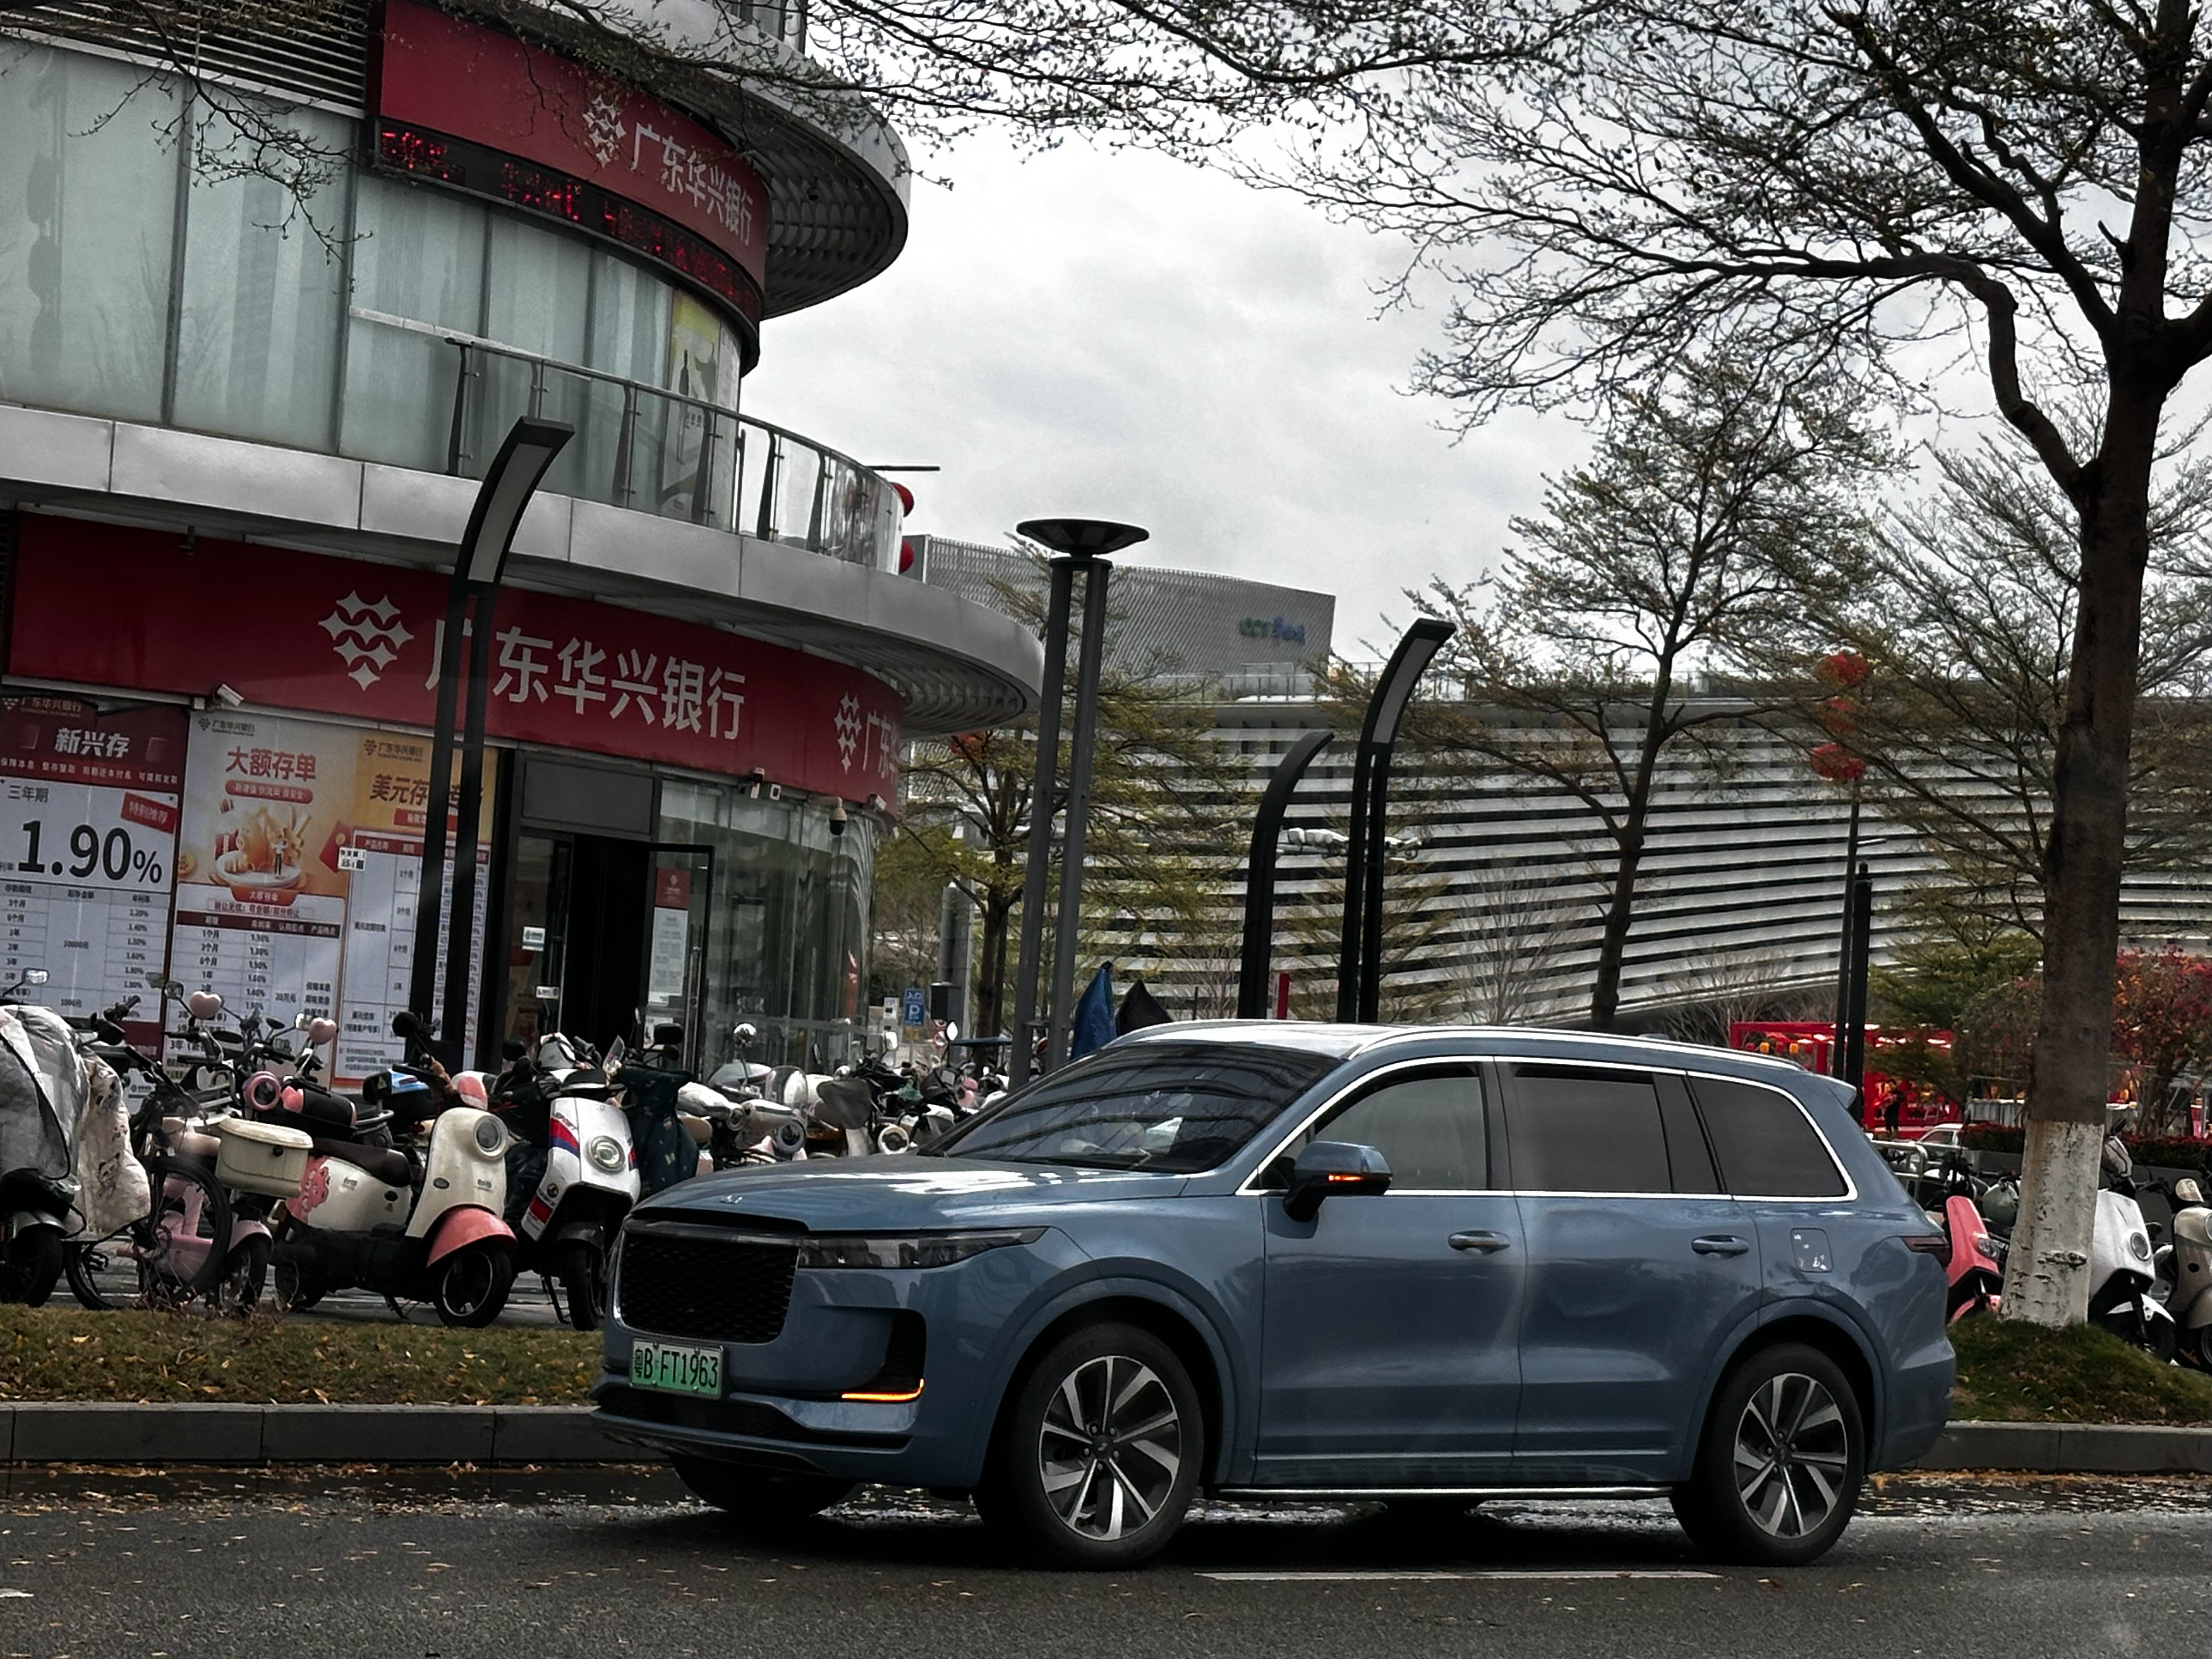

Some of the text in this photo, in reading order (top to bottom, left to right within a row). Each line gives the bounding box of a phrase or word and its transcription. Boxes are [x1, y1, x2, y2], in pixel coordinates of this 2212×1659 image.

[630, 122, 753, 246] 广东华兴银行
[54, 727, 131, 758] 新兴存
[225, 746, 316, 782] 大额存单
[8, 785, 49, 803] 三年期
[128, 800, 170, 825] 特别推荐
[18, 820, 162, 883] 1.90%
[202, 929, 219, 939] 1个月
[199, 956, 217, 967] 6个月
[202, 970, 213, 979] 1年
[909, 1005, 921, 1020] P
